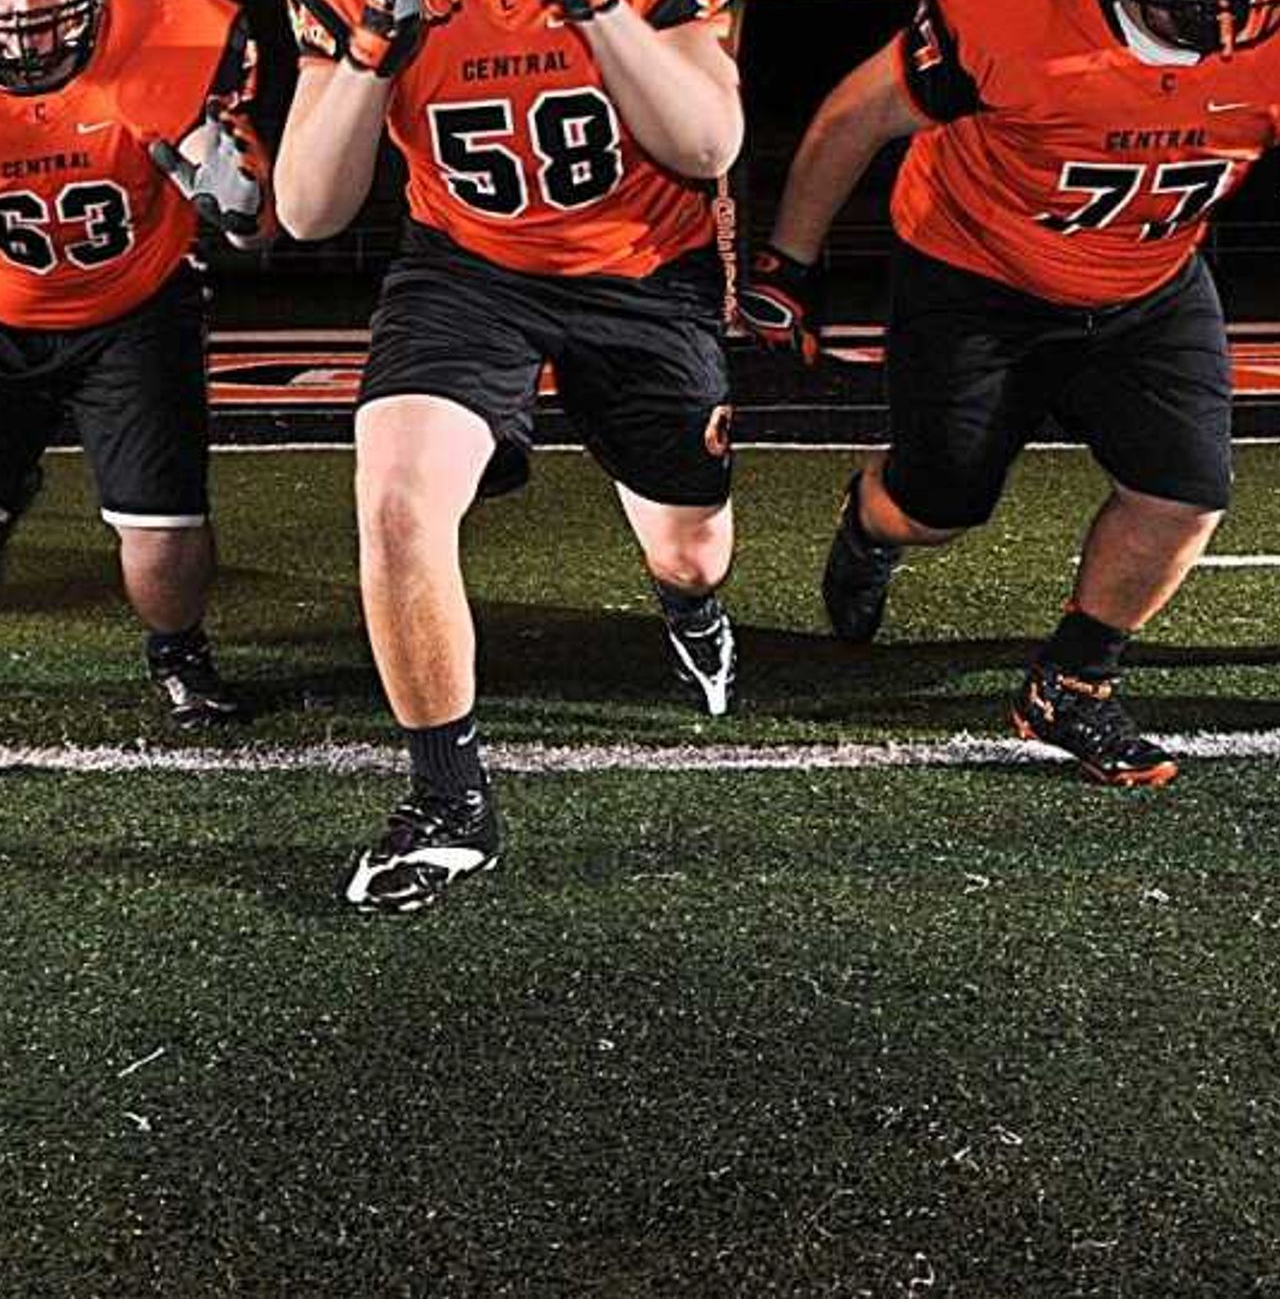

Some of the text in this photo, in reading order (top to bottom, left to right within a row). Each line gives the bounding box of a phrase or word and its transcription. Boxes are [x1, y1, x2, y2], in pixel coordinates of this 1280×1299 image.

[462, 52, 569, 82] CENTRAL
[426, 84, 624, 218] 58
[1105, 130, 1206, 150] CENTRAL
[1, 152, 91, 178] CENTRAL
[1032, 159, 1236, 242] 77
